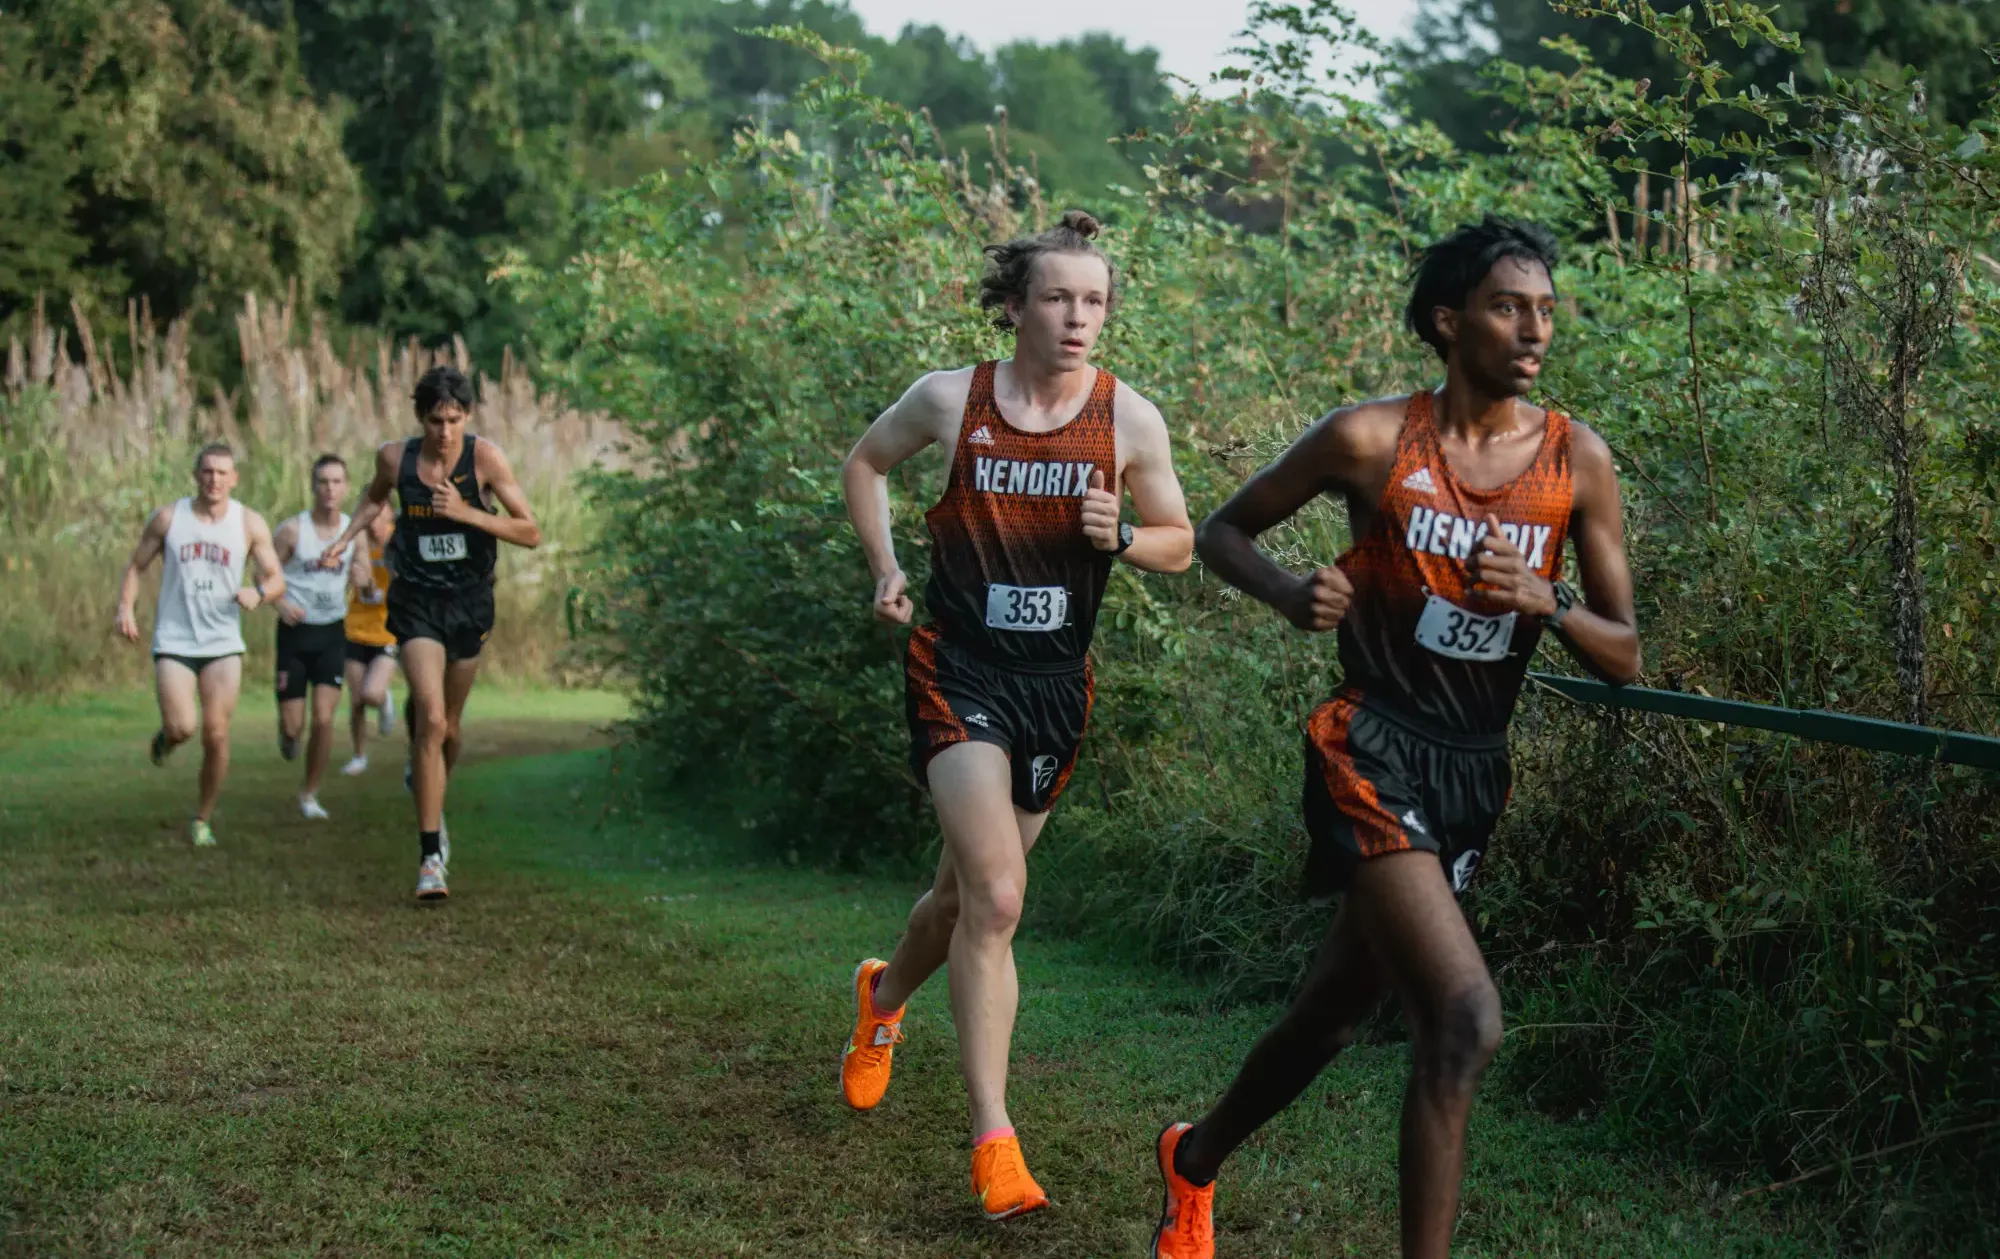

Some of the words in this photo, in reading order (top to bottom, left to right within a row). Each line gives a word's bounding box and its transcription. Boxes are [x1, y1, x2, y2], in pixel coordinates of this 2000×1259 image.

[974, 457, 1094, 497] HENDRIX
[180, 541, 230, 568] UNION
[428, 536, 456, 557] 448
[1004, 589, 1052, 625] 353
[1438, 611, 1501, 653] 352
